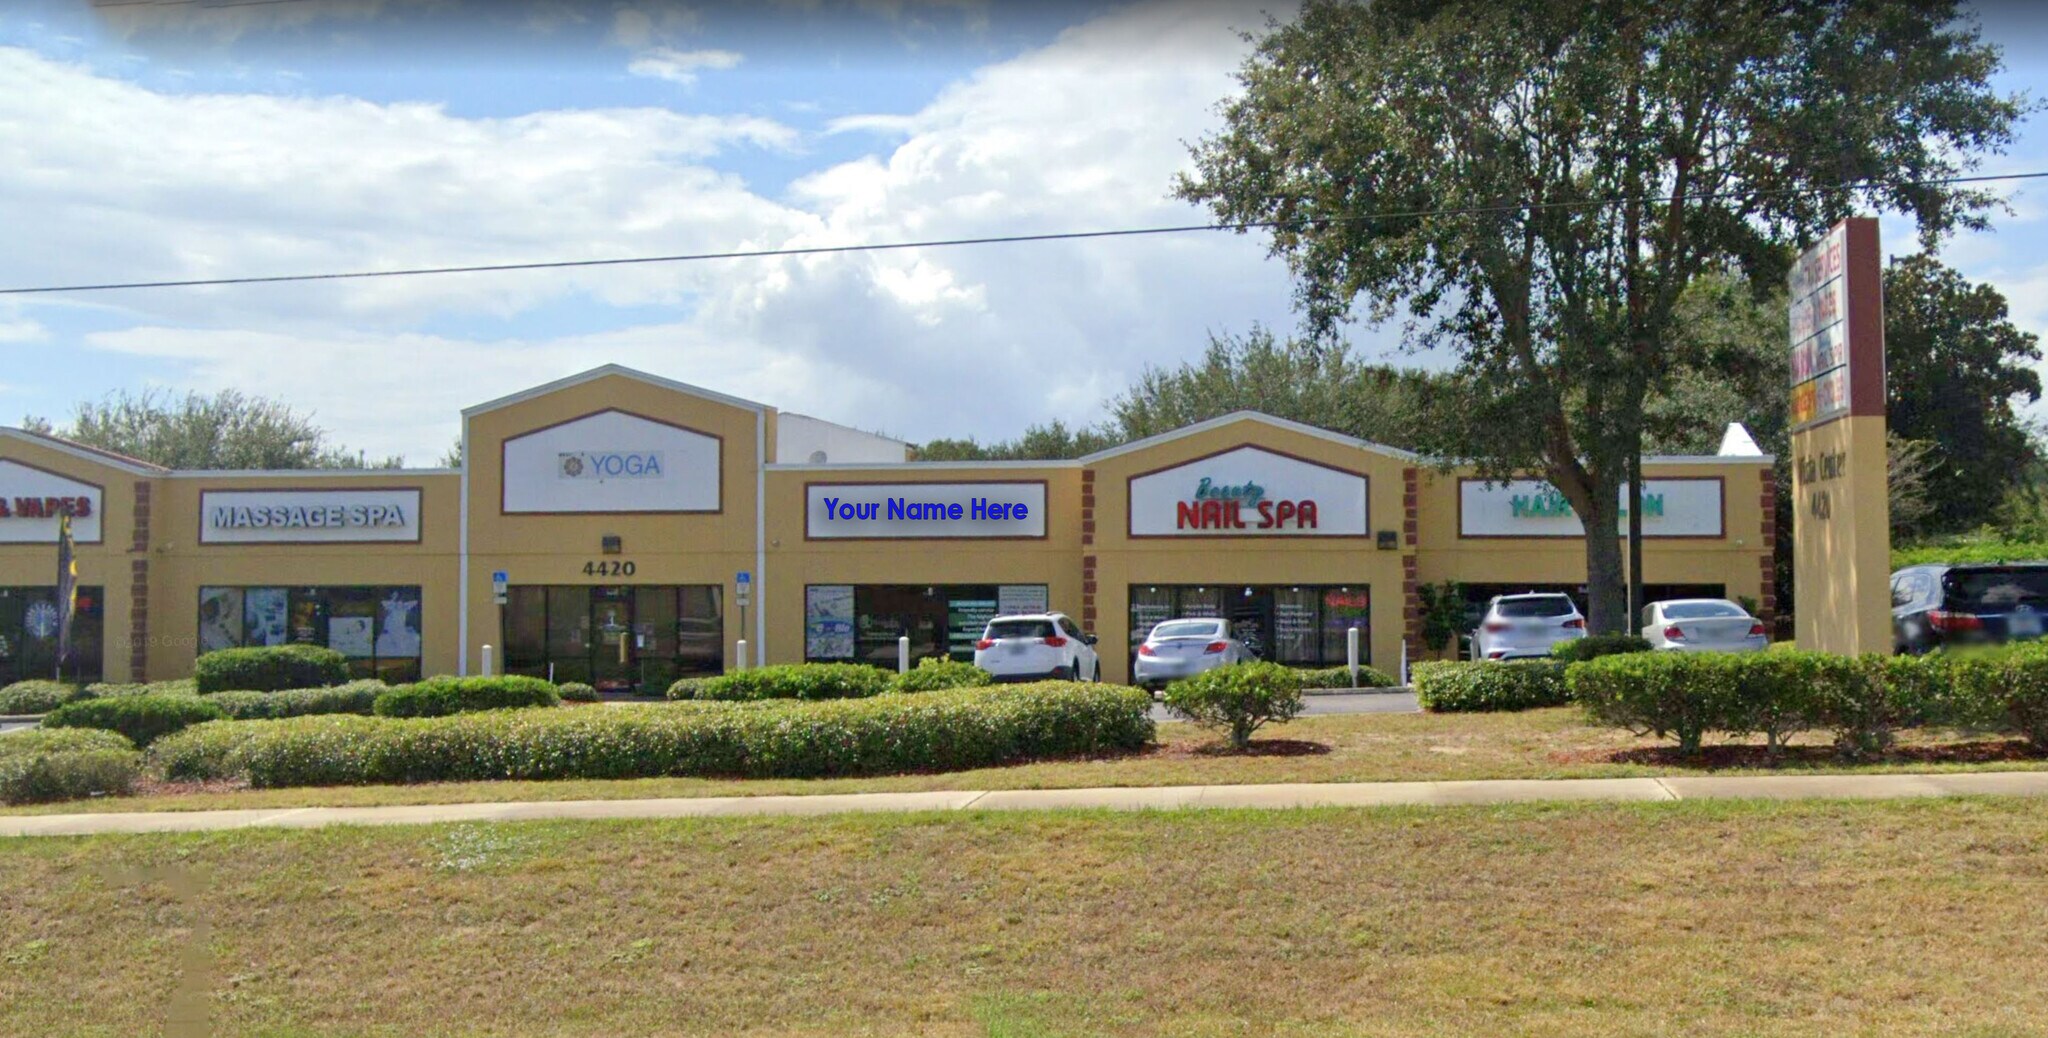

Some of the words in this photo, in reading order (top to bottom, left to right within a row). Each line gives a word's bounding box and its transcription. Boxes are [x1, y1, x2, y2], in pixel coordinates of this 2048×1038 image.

[591, 454, 660, 476] YOGA
[1195, 477, 1265, 508] Beauty
[14, 496, 91, 518] VAPES
[214, 506, 344, 529] MASSAGE
[352, 505, 405, 527] SPA
[1177, 501, 1246, 530] NAIL
[1257, 500, 1318, 529] SPA
[582, 561, 636, 577] 4420
